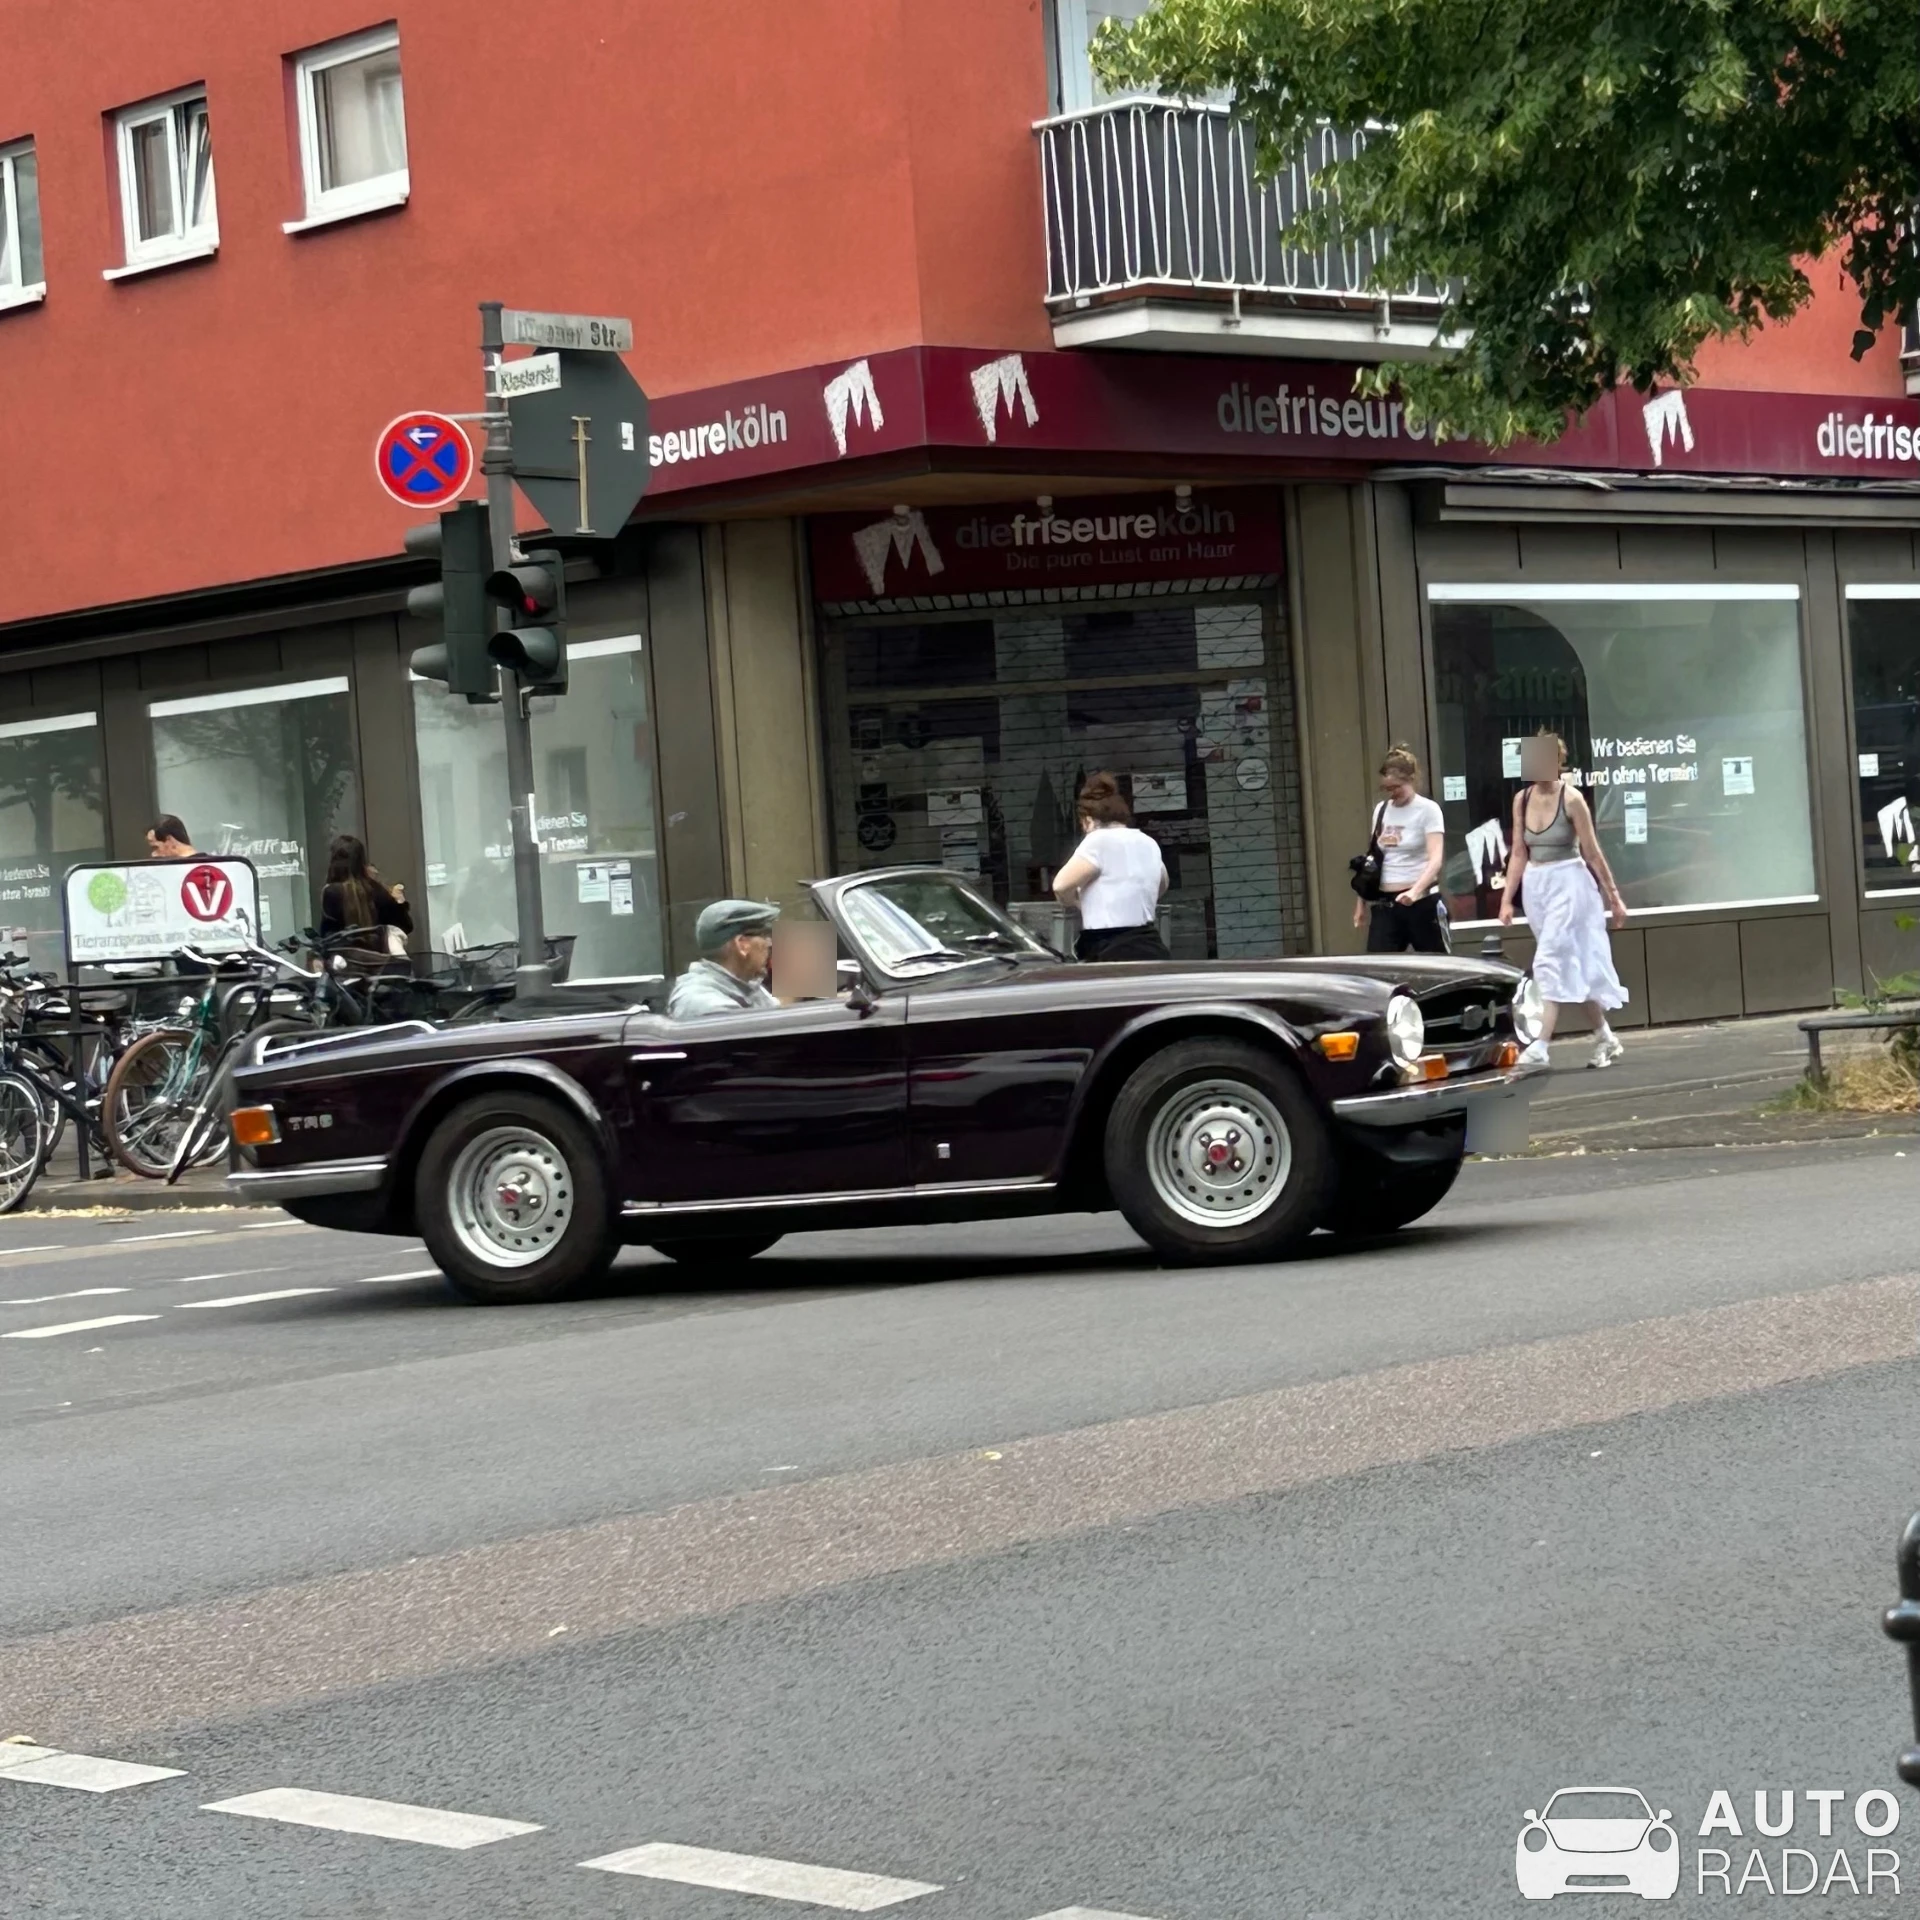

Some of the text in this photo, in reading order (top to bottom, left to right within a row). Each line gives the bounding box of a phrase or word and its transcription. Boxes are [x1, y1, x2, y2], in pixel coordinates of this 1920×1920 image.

[590, 321, 622, 348] Str.
[956, 503, 1235, 549] diefriseureköln
[1047, 552, 1093, 571] pure
[1099, 546, 1144, 565] Lust
[1150, 546, 1181, 562] am
[1188, 540, 1236, 559] Haar
[1591, 734, 1697, 757] Wir bedienen Sie
[1585, 766, 1610, 787] und
[1612, 765, 1647, 785] ohne
[537, 816, 570, 831] dienen
